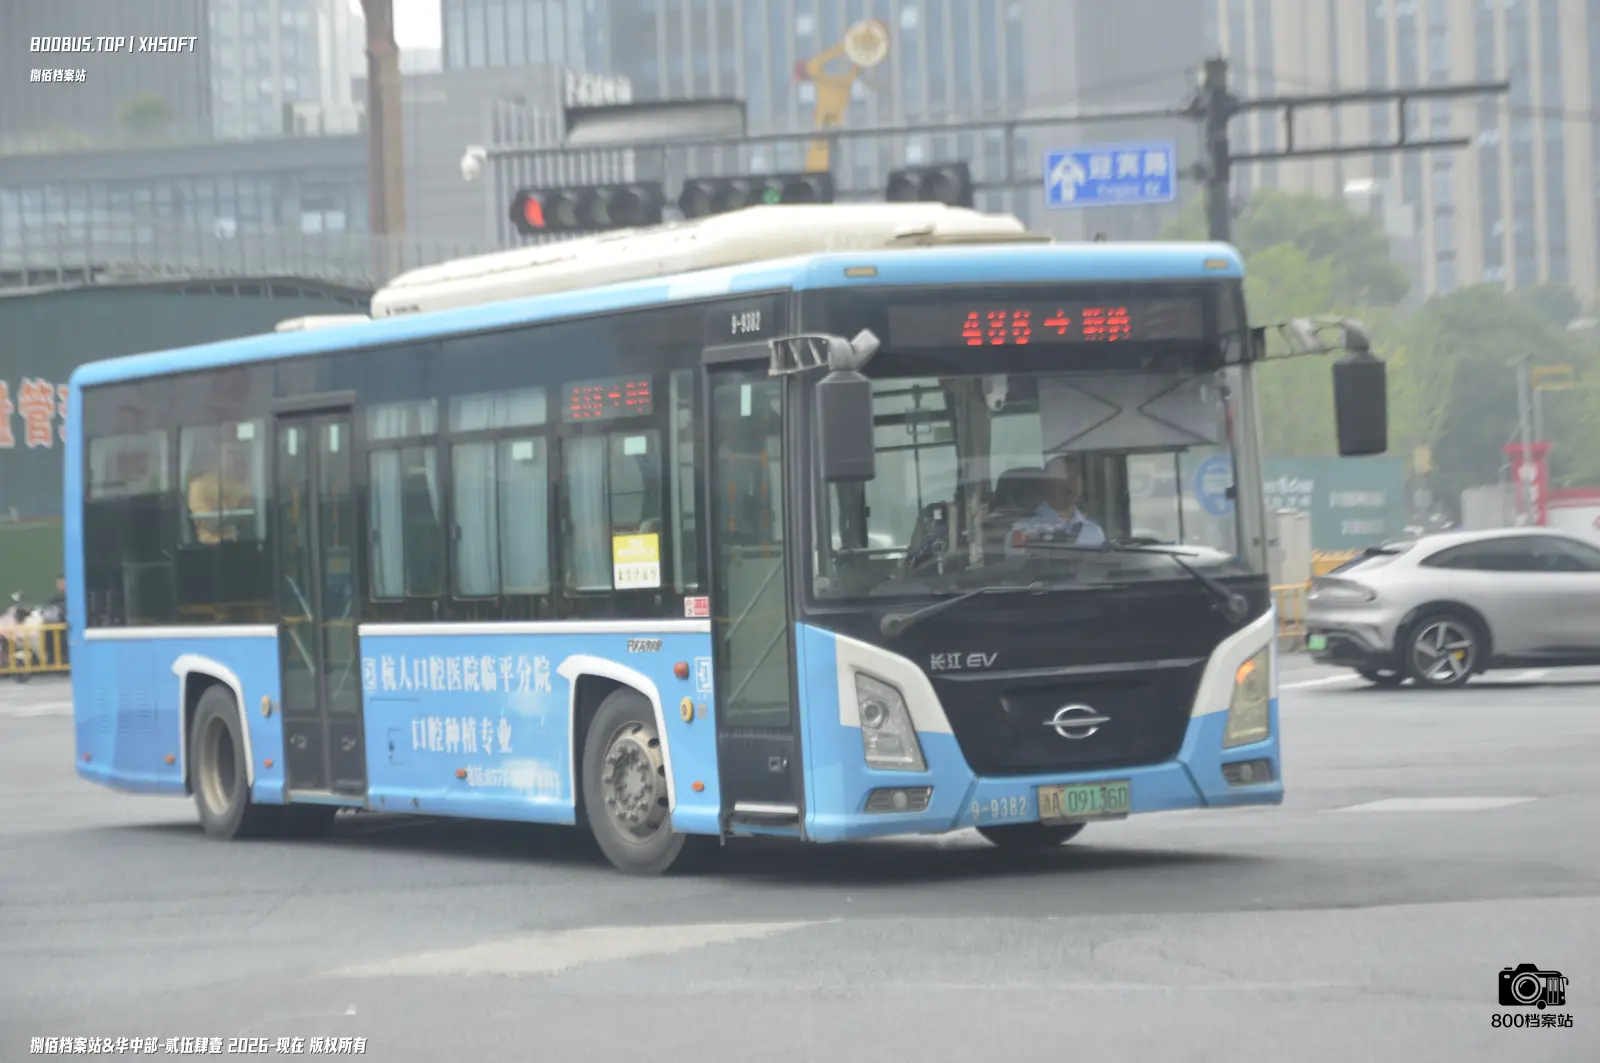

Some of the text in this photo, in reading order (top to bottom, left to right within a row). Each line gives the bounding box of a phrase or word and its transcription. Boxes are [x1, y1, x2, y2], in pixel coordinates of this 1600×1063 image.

[731, 311, 761, 334] 9-9382
[929, 651, 998, 671] 长江 EV
[971, 795, 1027, 821] 9-9382
